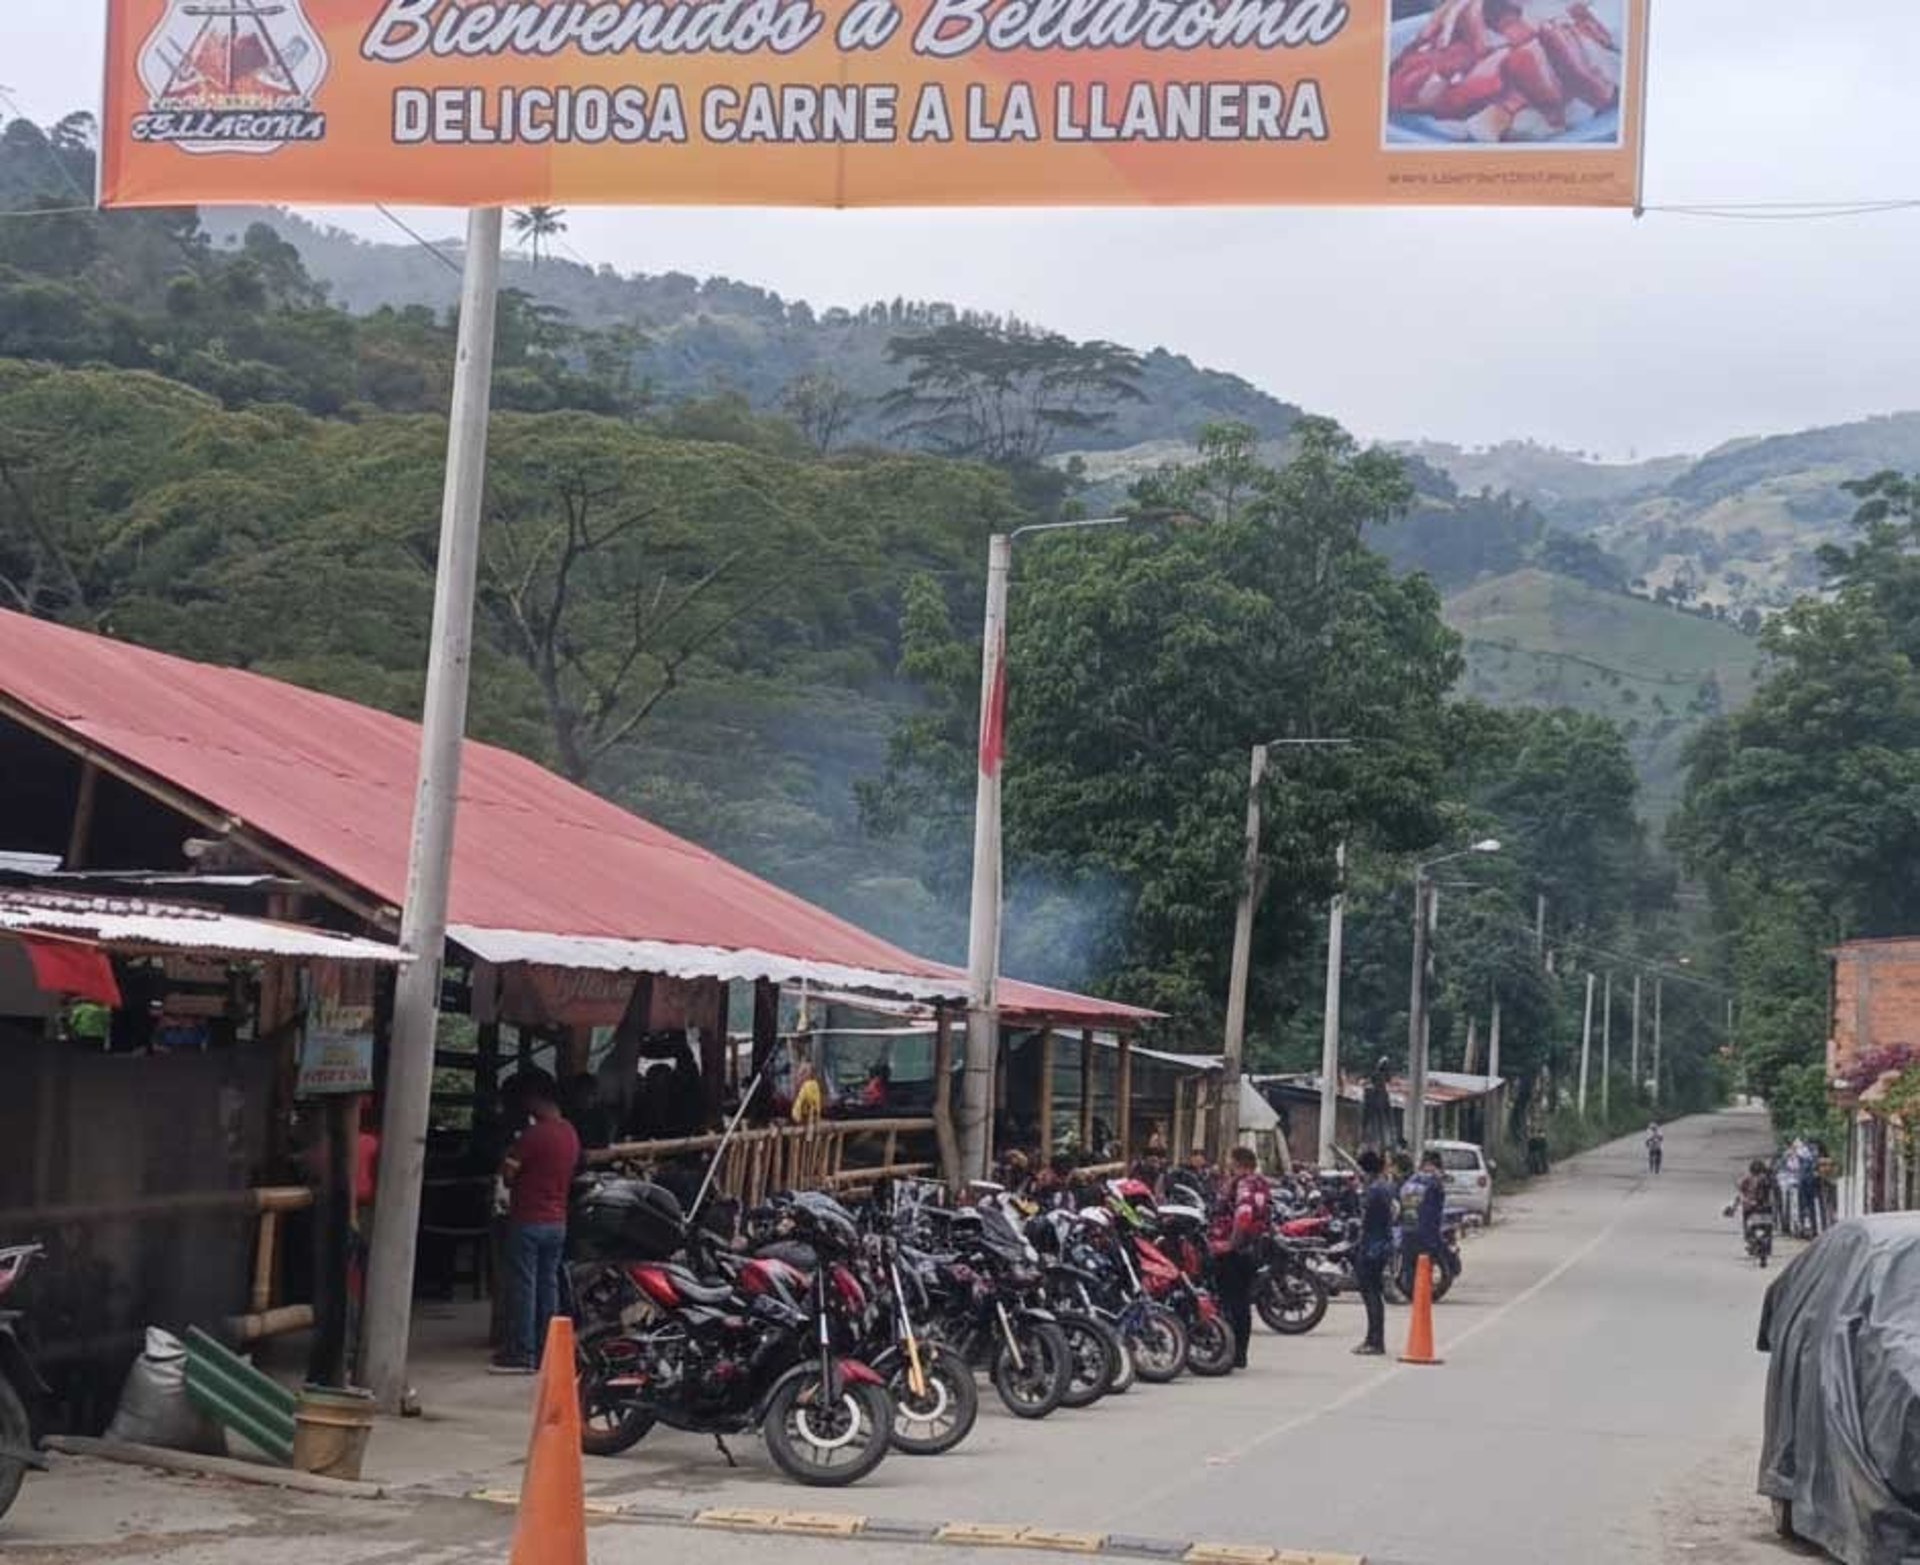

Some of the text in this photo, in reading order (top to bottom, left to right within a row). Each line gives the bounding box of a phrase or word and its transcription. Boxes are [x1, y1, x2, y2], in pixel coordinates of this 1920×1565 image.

[362, 0, 1347, 60] Bienvenidos a Bellaroma
[394, 81, 1327, 143] DELICIOSA CARNE A LA LLANERA
